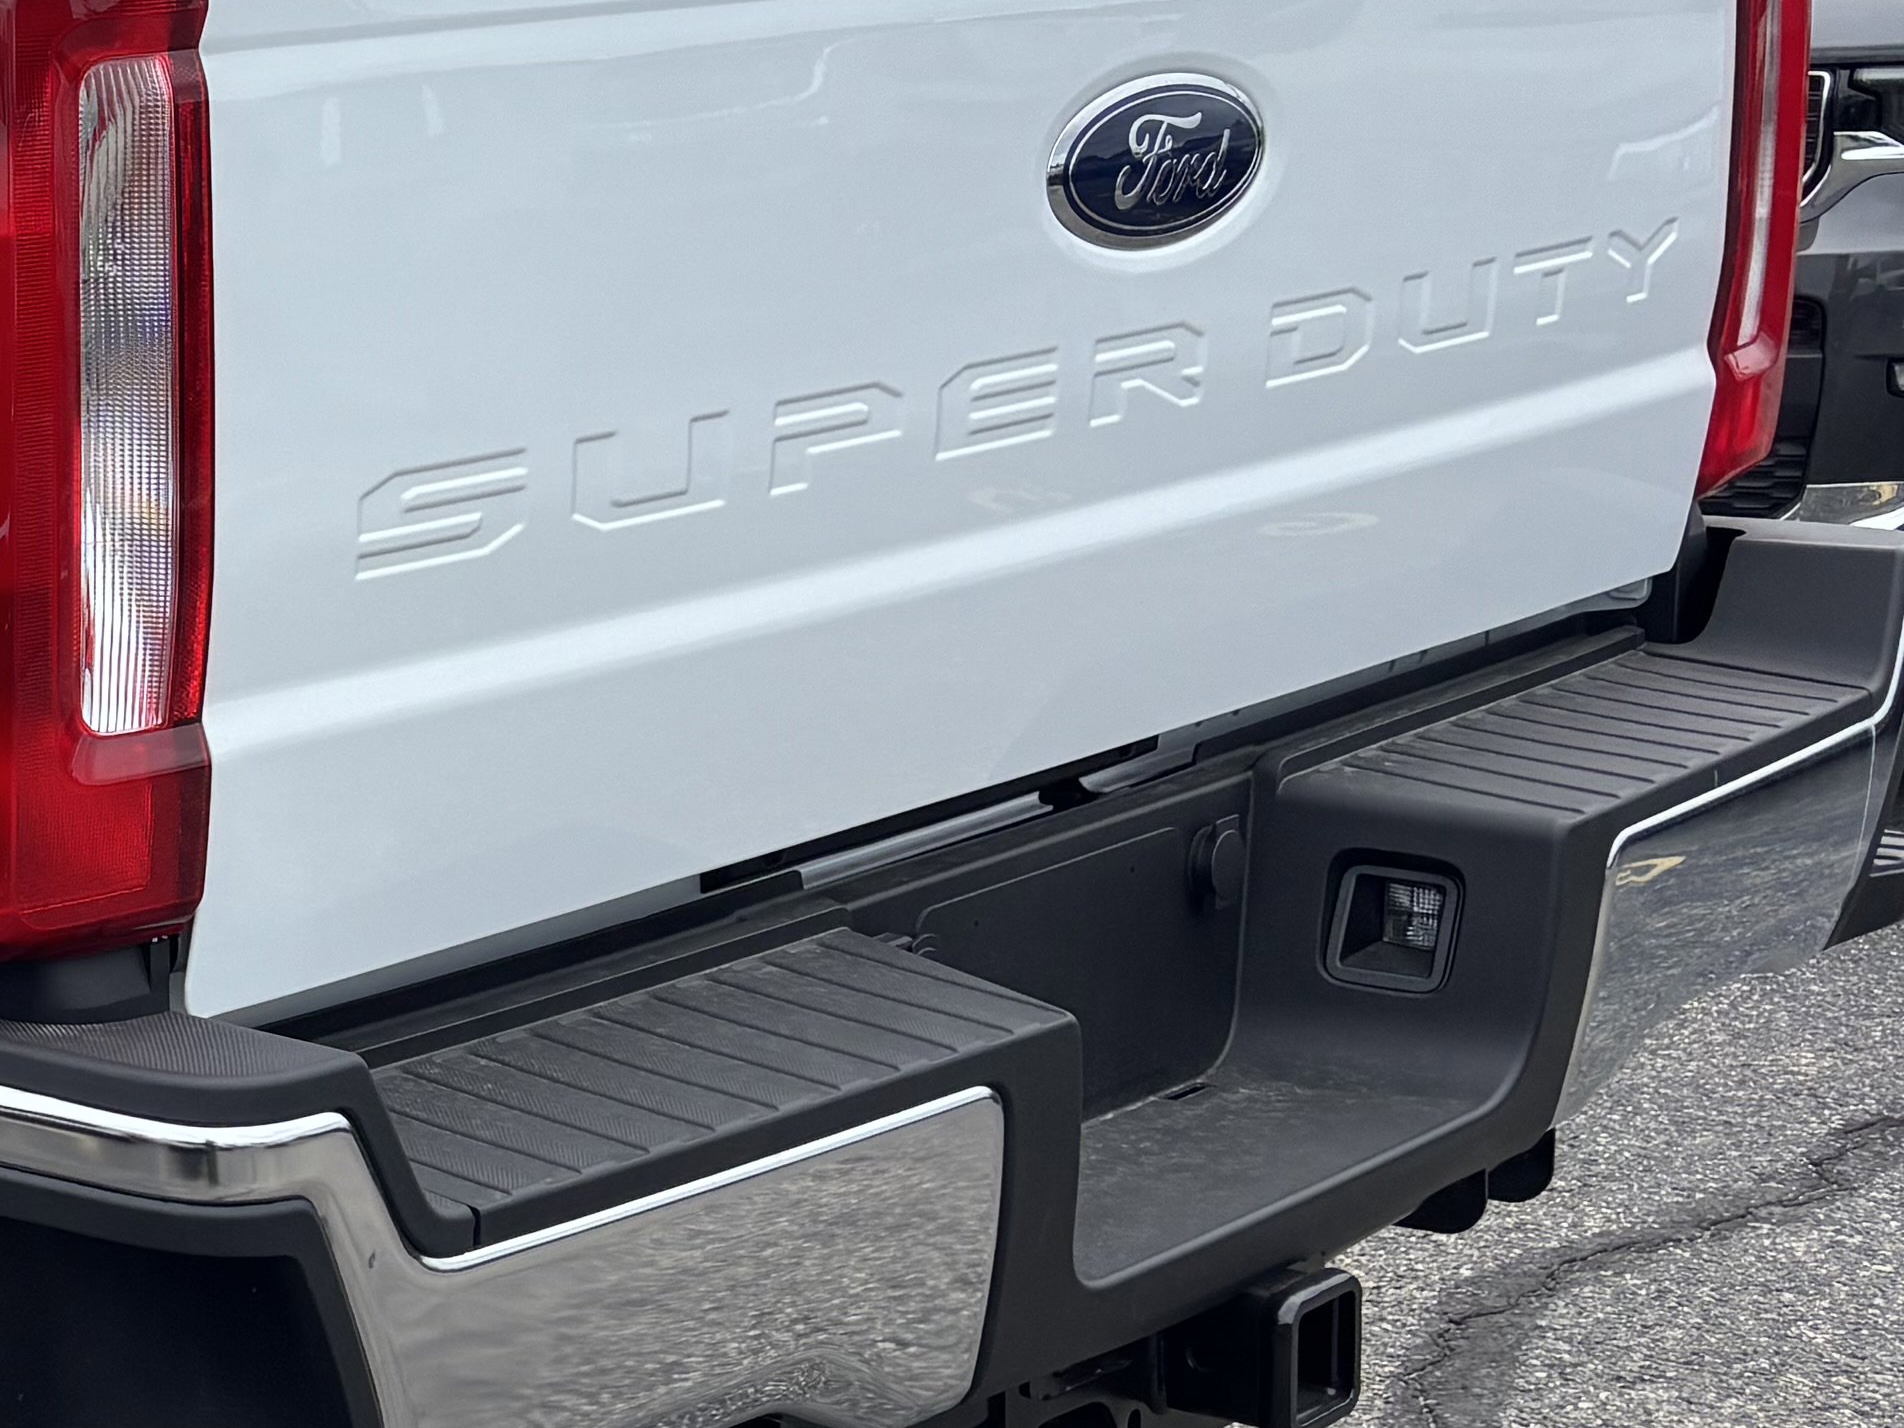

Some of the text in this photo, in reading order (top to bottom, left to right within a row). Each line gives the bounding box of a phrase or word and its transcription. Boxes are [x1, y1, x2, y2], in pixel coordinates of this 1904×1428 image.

[1114, 111, 1231, 211] Ford
[353, 217, 1680, 581] SUPER DUTY
